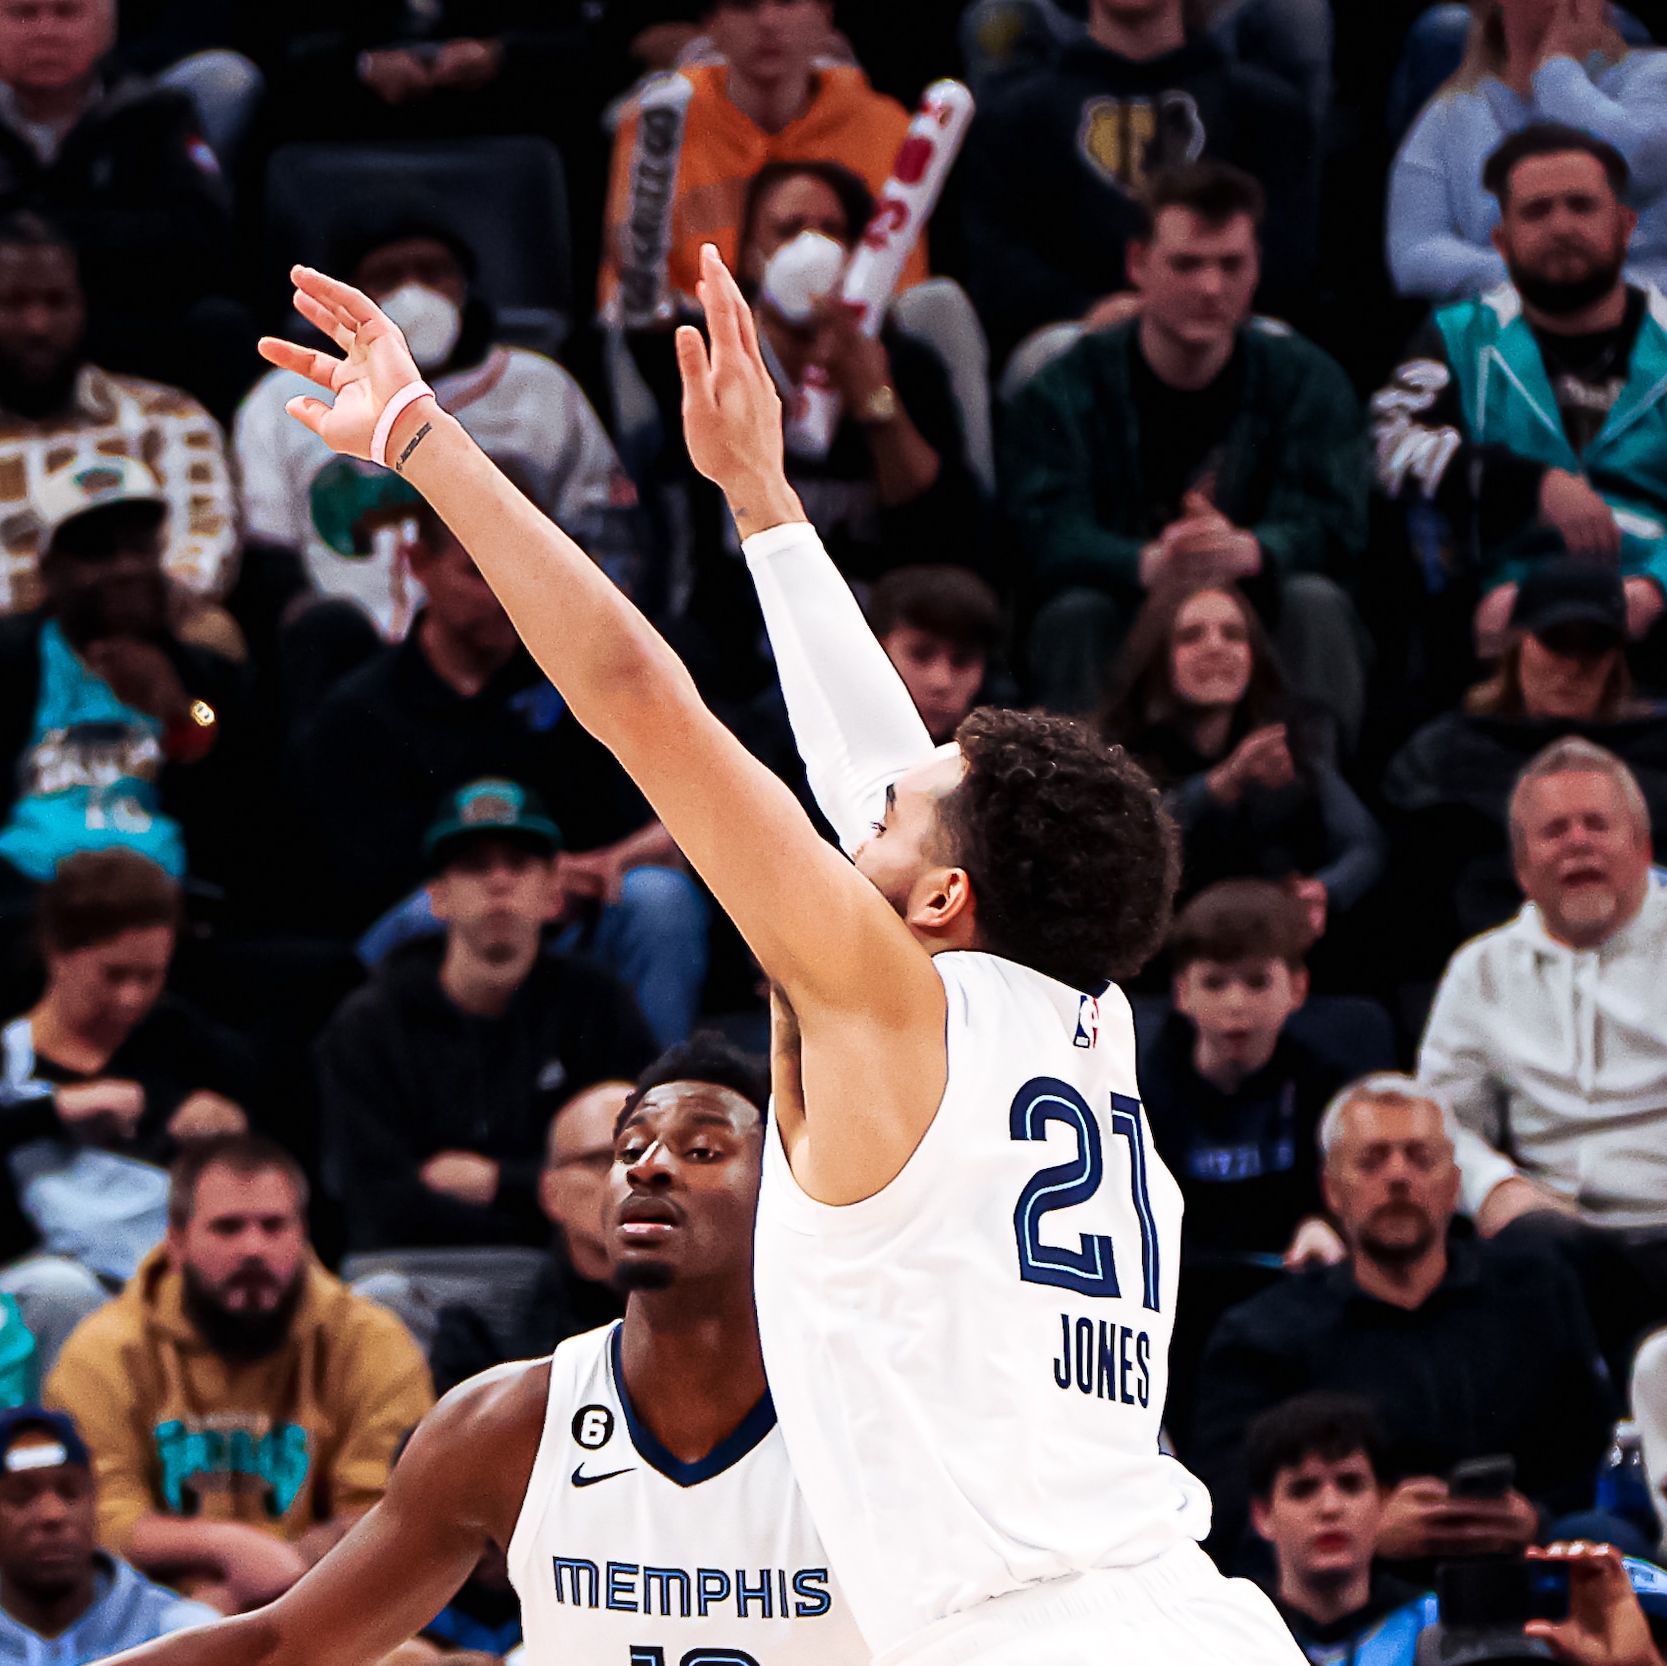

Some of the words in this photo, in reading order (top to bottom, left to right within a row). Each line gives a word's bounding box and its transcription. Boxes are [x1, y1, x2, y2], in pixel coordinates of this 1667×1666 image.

[1009, 1076, 1160, 1313] 21
[1053, 1313, 1151, 1409] JONES
[580, 1409, 609, 1447] 6
[553, 1555, 832, 1619] MEMPHIS
